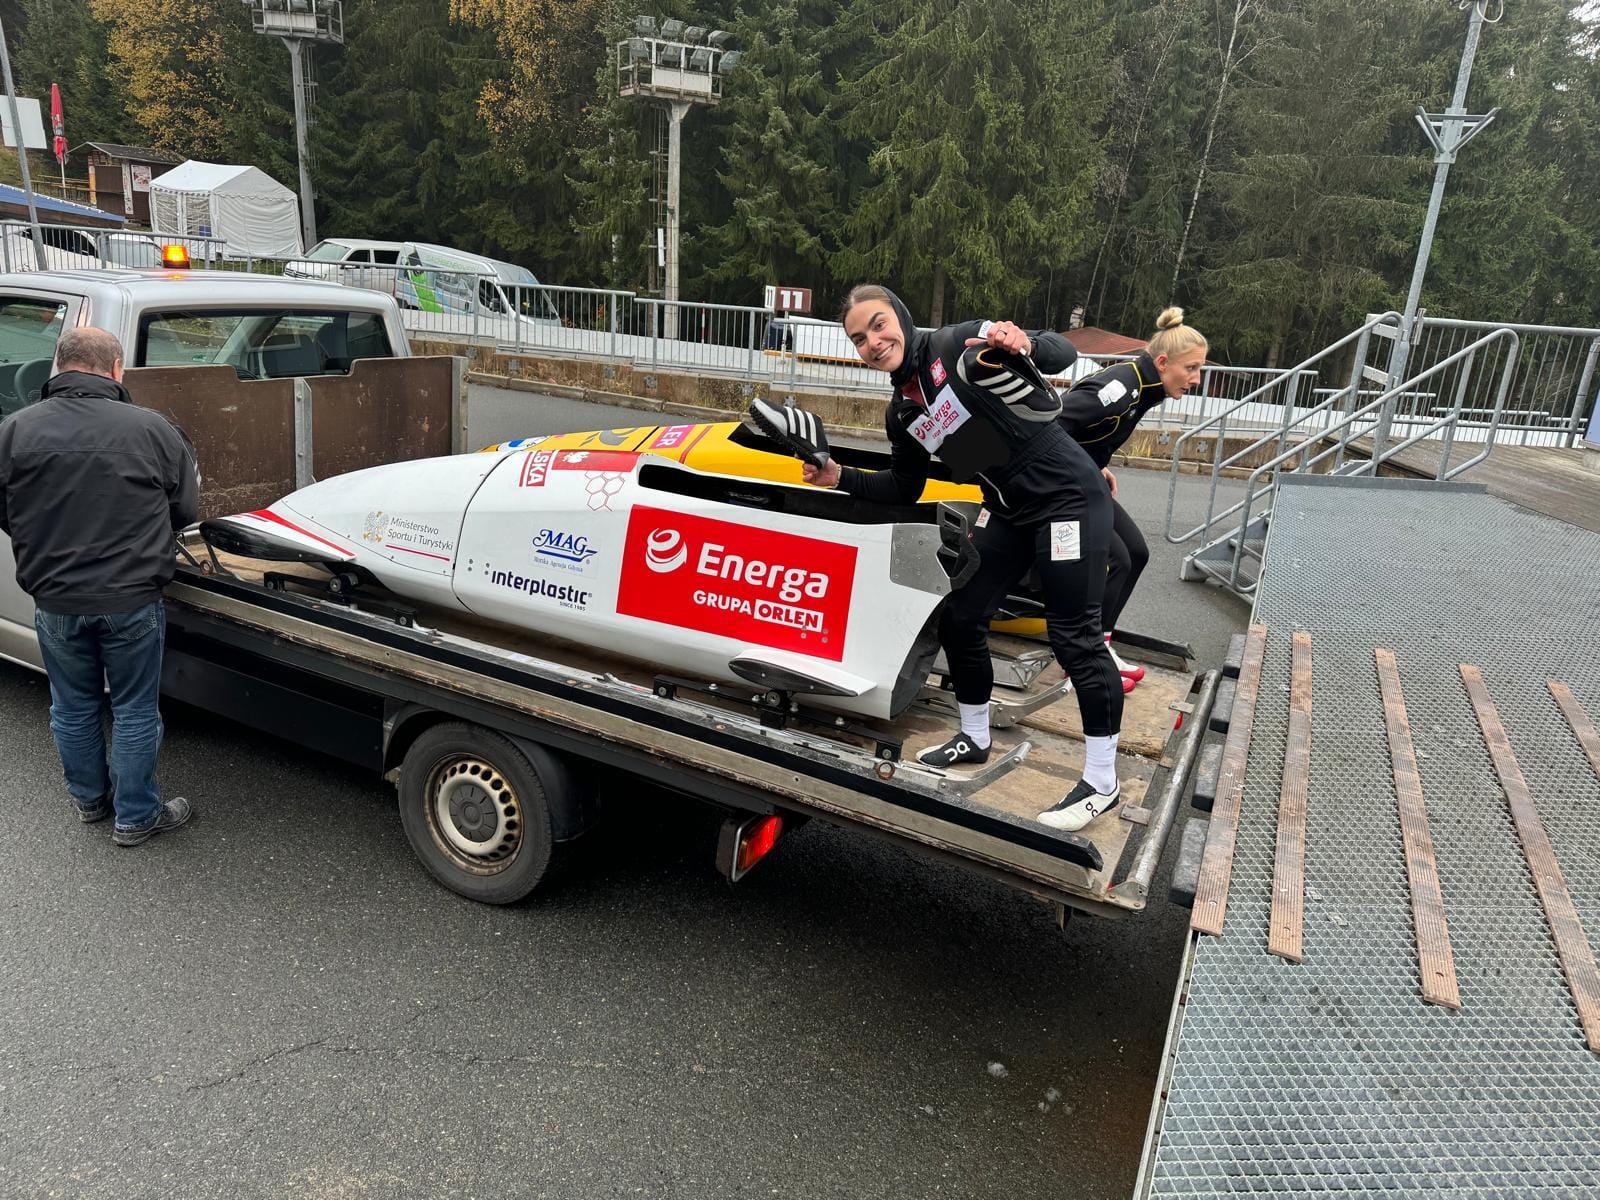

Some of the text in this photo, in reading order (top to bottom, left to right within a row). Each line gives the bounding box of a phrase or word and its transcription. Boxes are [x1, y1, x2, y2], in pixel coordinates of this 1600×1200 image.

[780, 290, 803, 309] 11
[387, 528, 454, 551] Sportu i Turystyki
[390, 516, 439, 535] Ministerstwo
[532, 528, 589, 556] MAG
[696, 542, 830, 603] Energa
[491, 570, 588, 605] interplastic
[693, 590, 819, 629] GRUPA ORLEN
